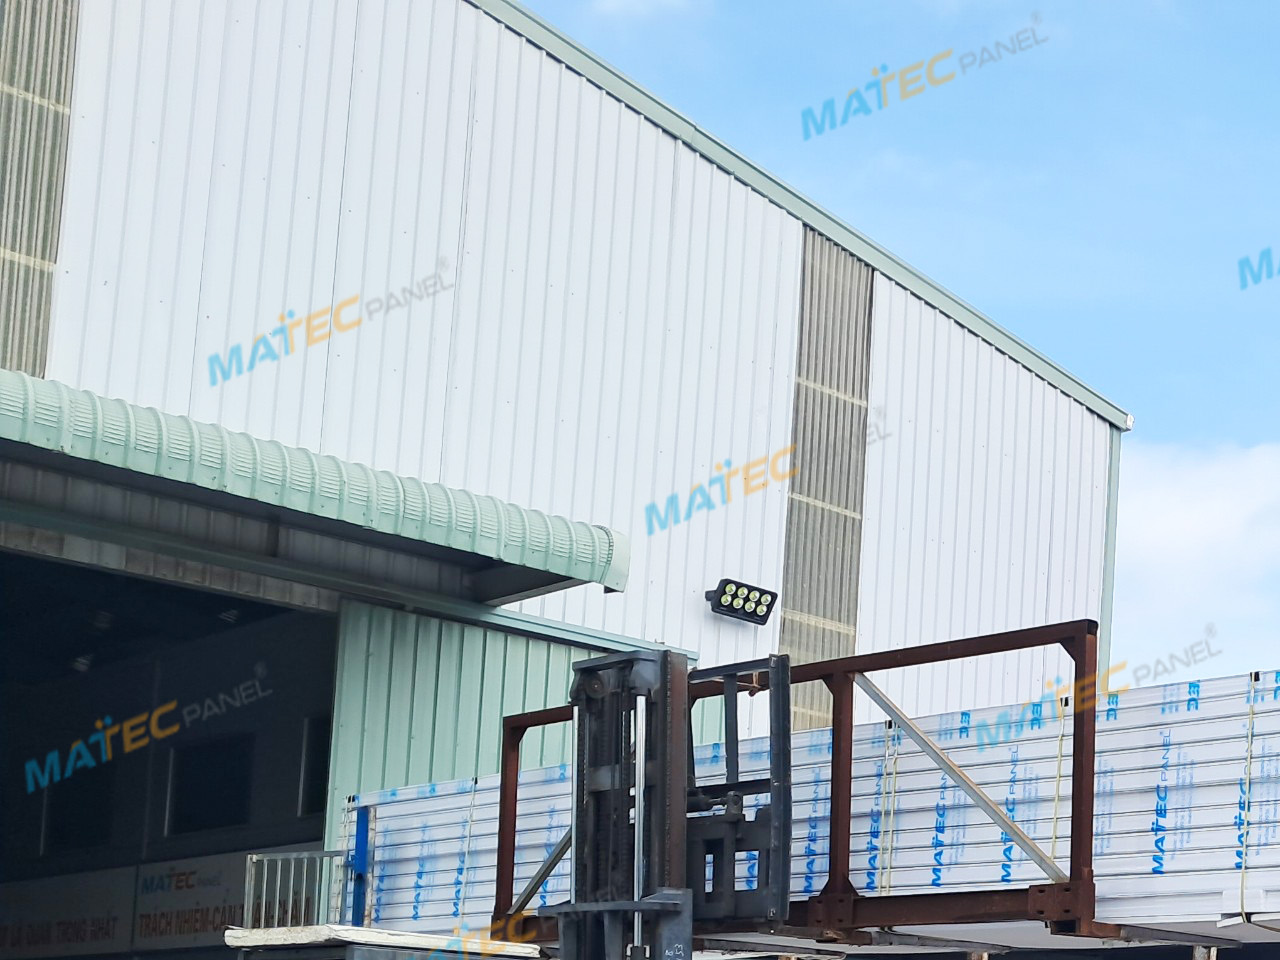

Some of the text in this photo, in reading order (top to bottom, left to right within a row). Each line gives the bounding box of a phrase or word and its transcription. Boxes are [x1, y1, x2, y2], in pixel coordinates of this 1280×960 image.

[1009, 745, 1019, 794] PANEL
[1151, 729, 1171, 875] MATEC PANEL
[802, 814, 817, 893] MATEC
[865, 808, 880, 891] MATEC
[932, 802, 946, 887] MATEC
[1234, 778, 1252, 870] MATEC
[140, 867, 198, 895] MATEC
